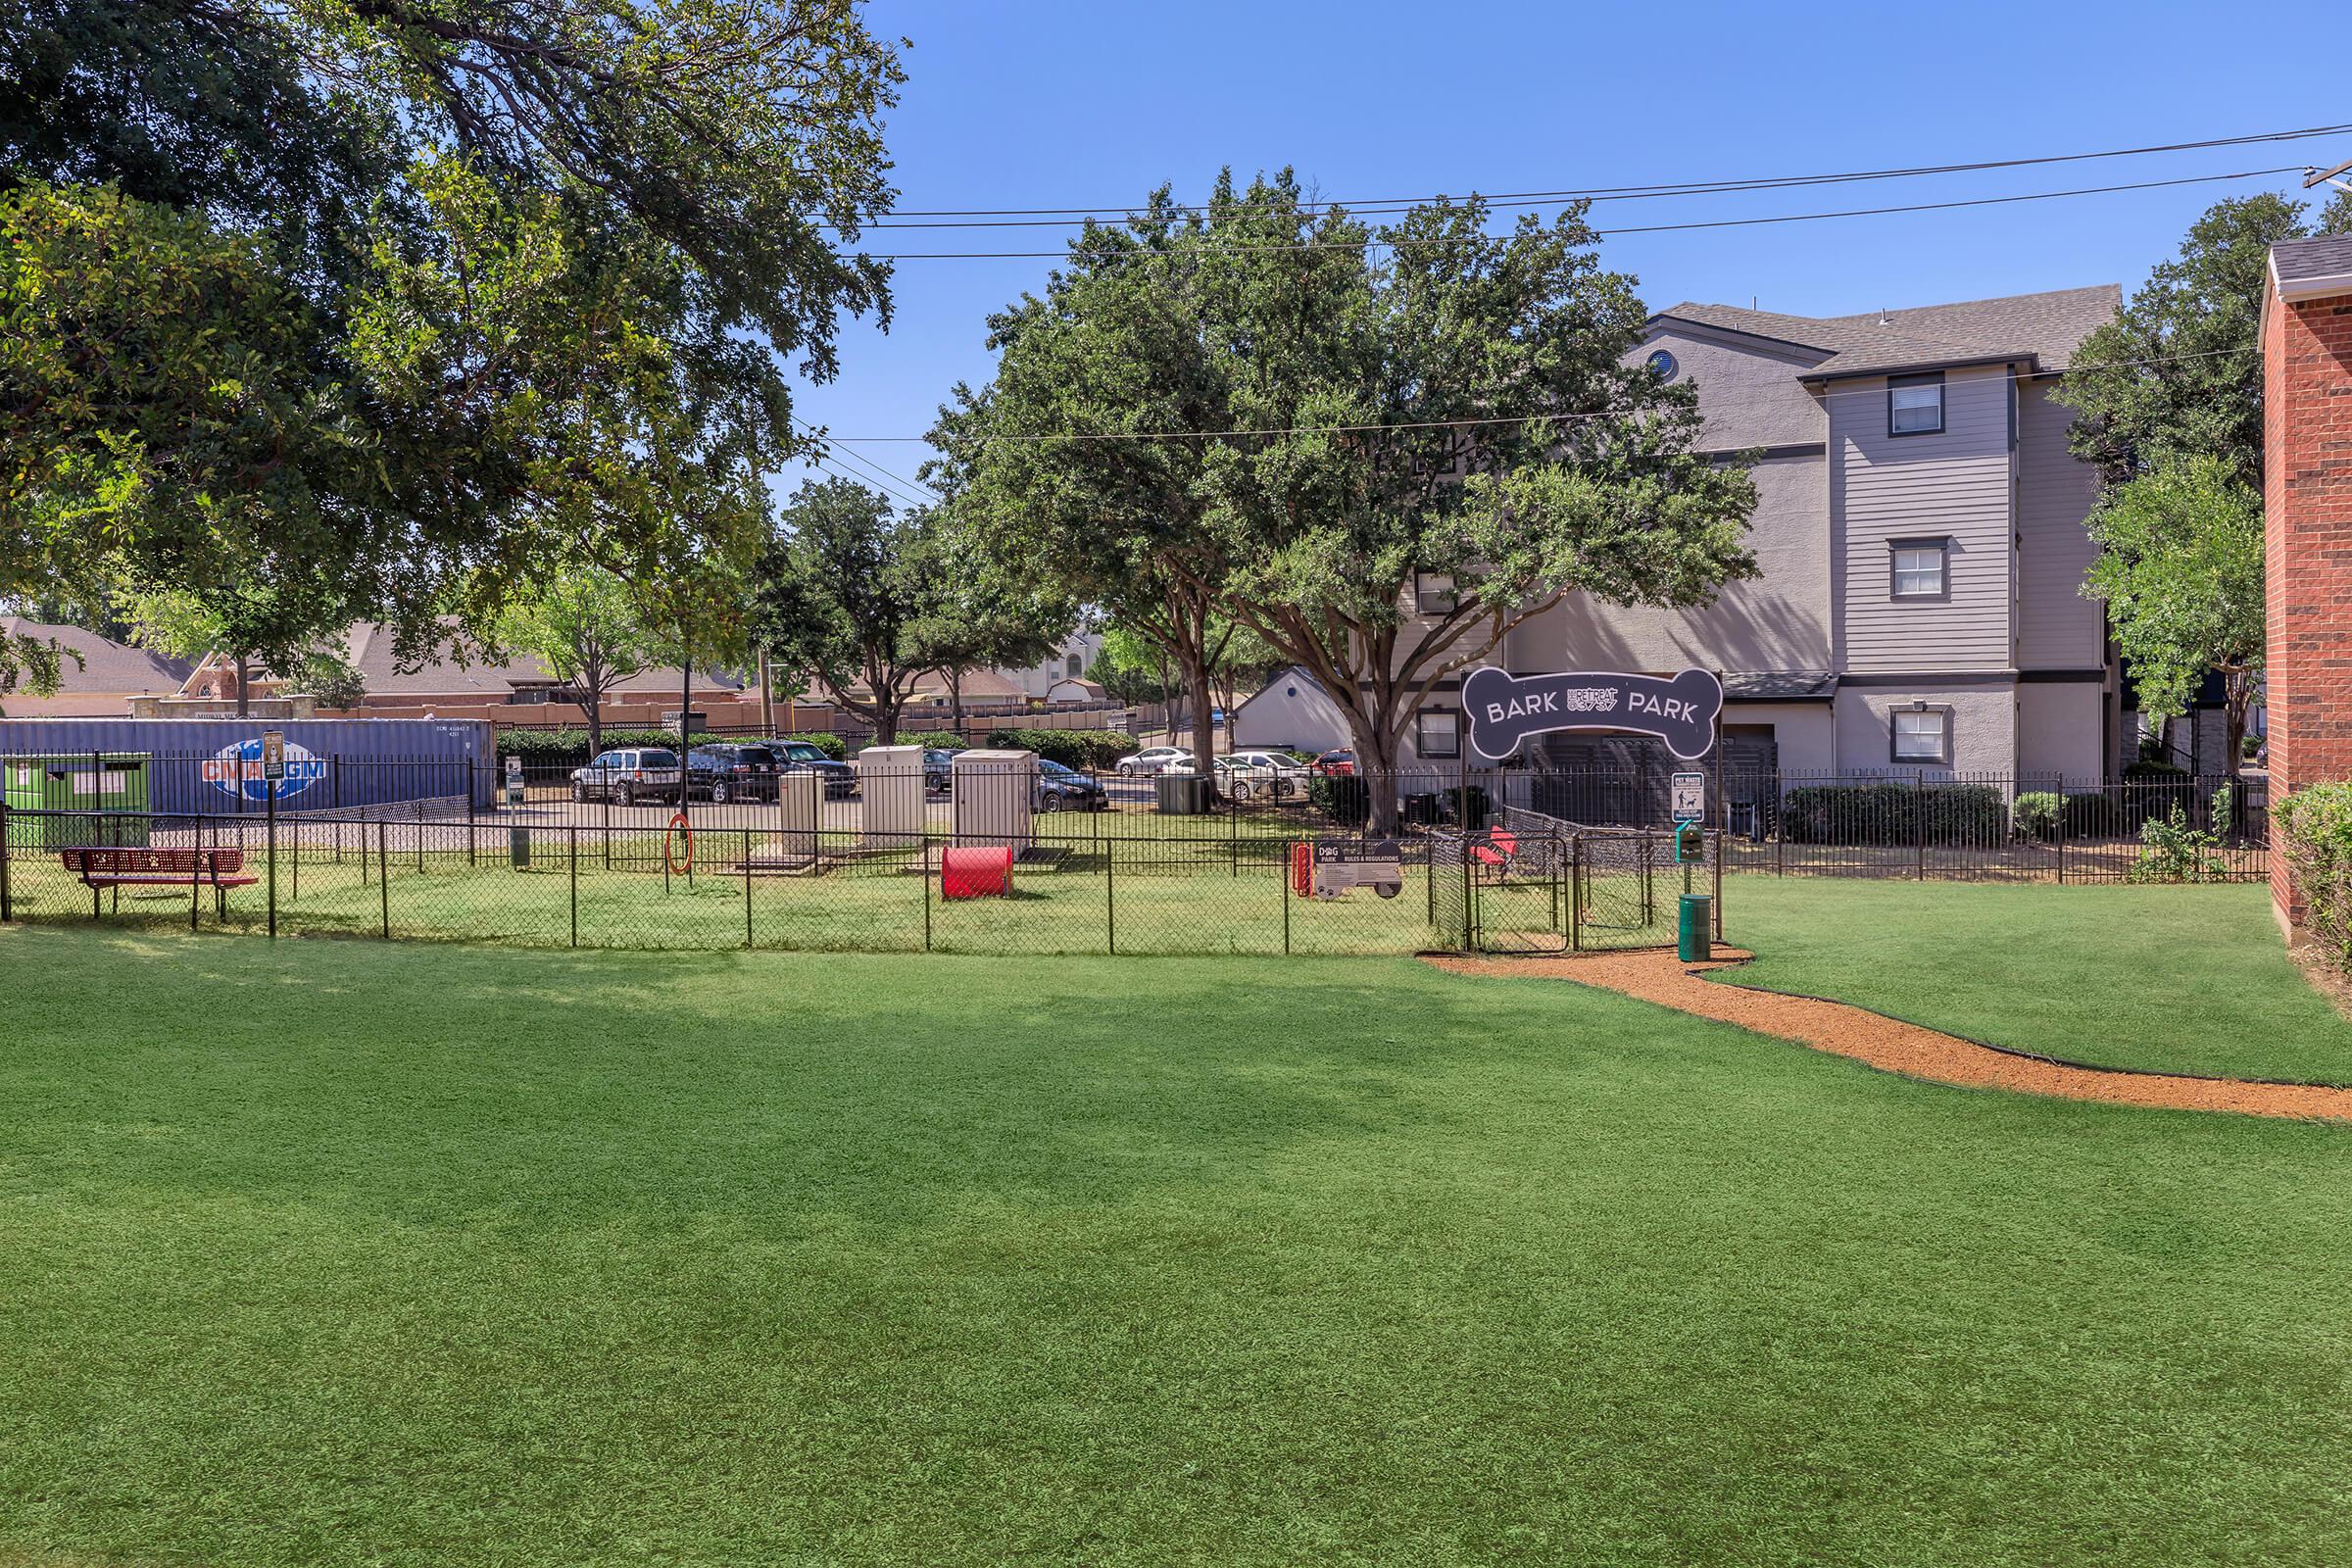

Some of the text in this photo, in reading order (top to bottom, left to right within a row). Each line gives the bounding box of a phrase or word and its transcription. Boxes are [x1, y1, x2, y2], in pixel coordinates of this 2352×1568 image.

[1577, 688, 1618, 702] RETREAT
[1487, 692, 1699, 723] BARK PARK
